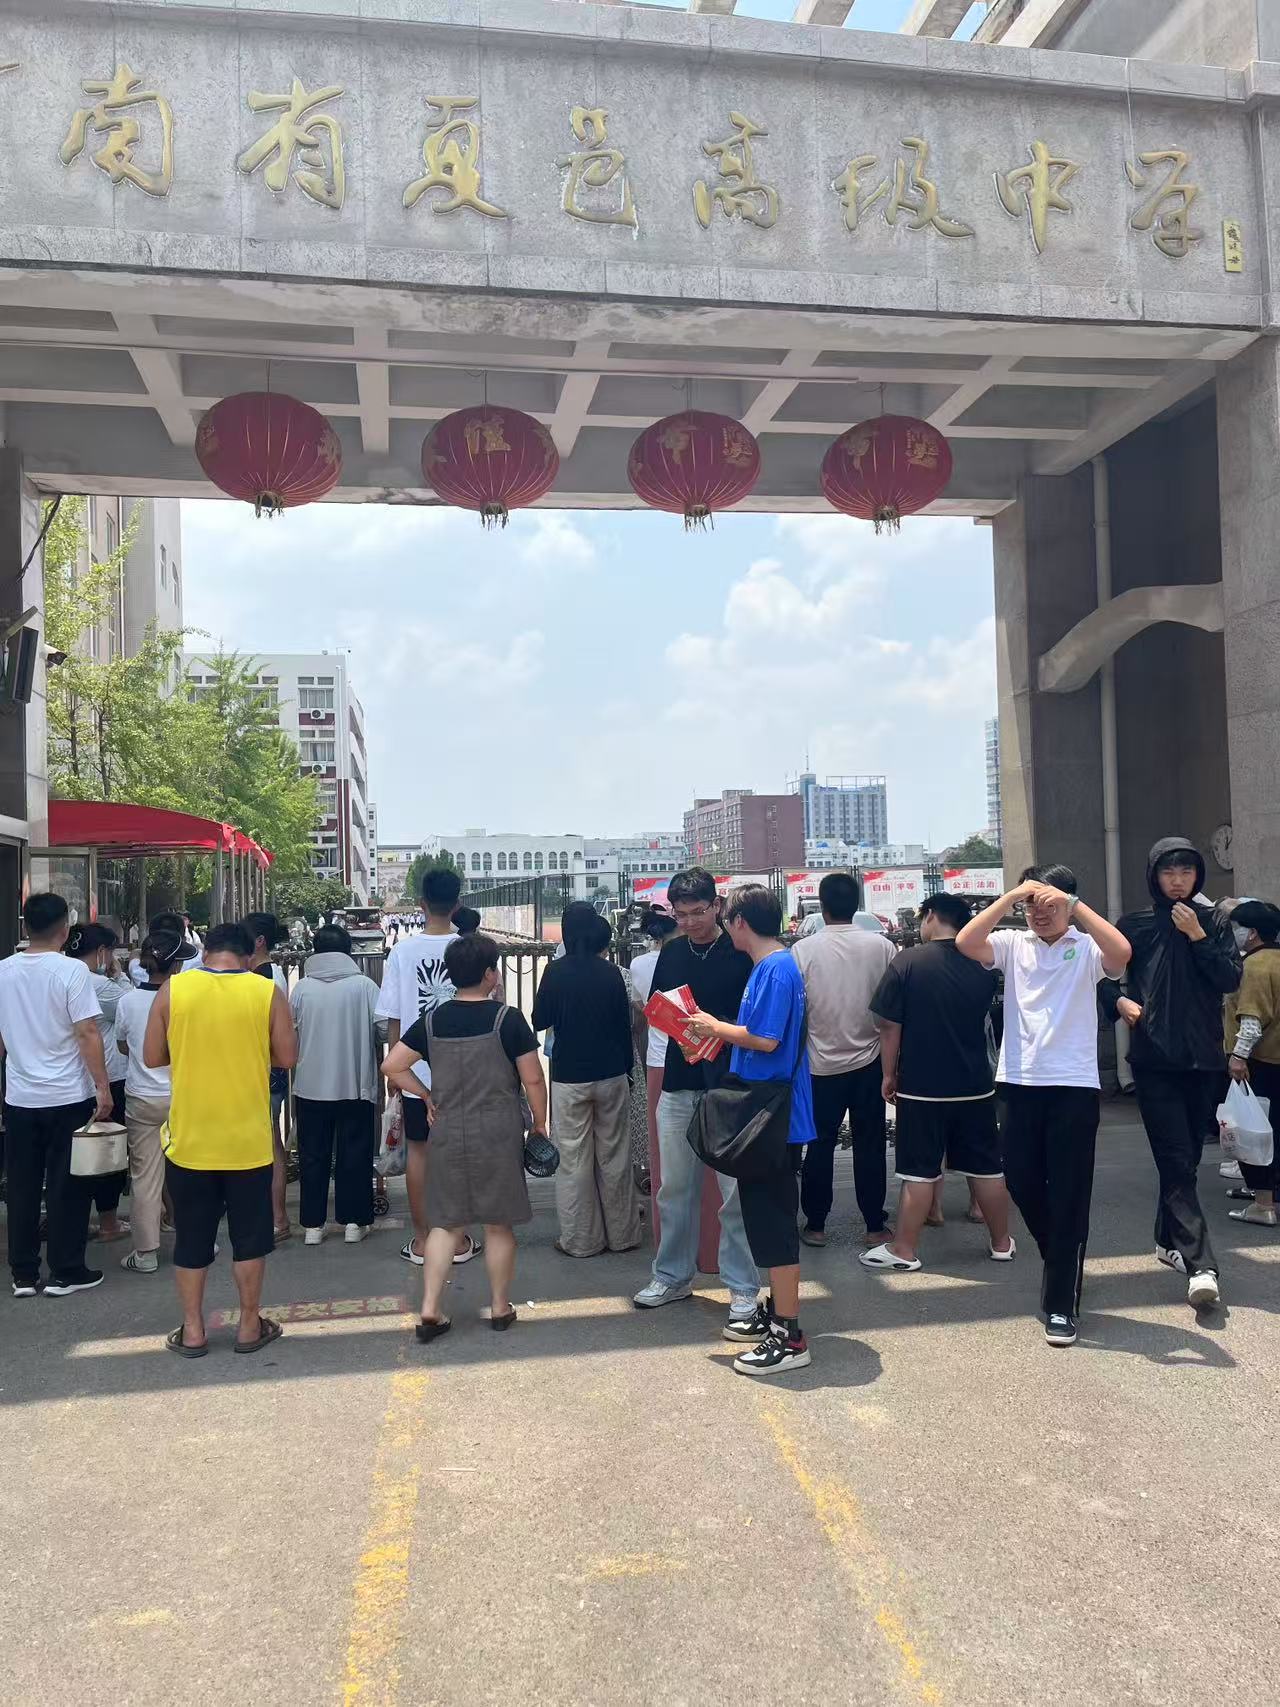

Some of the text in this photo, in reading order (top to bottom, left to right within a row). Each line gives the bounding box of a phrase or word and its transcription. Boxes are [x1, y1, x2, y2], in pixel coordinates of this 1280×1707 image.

[872, 882, 915, 892] 自由 平等
[953, 880, 995, 889] 公正 法治
[796, 885, 814, 894] 文明
